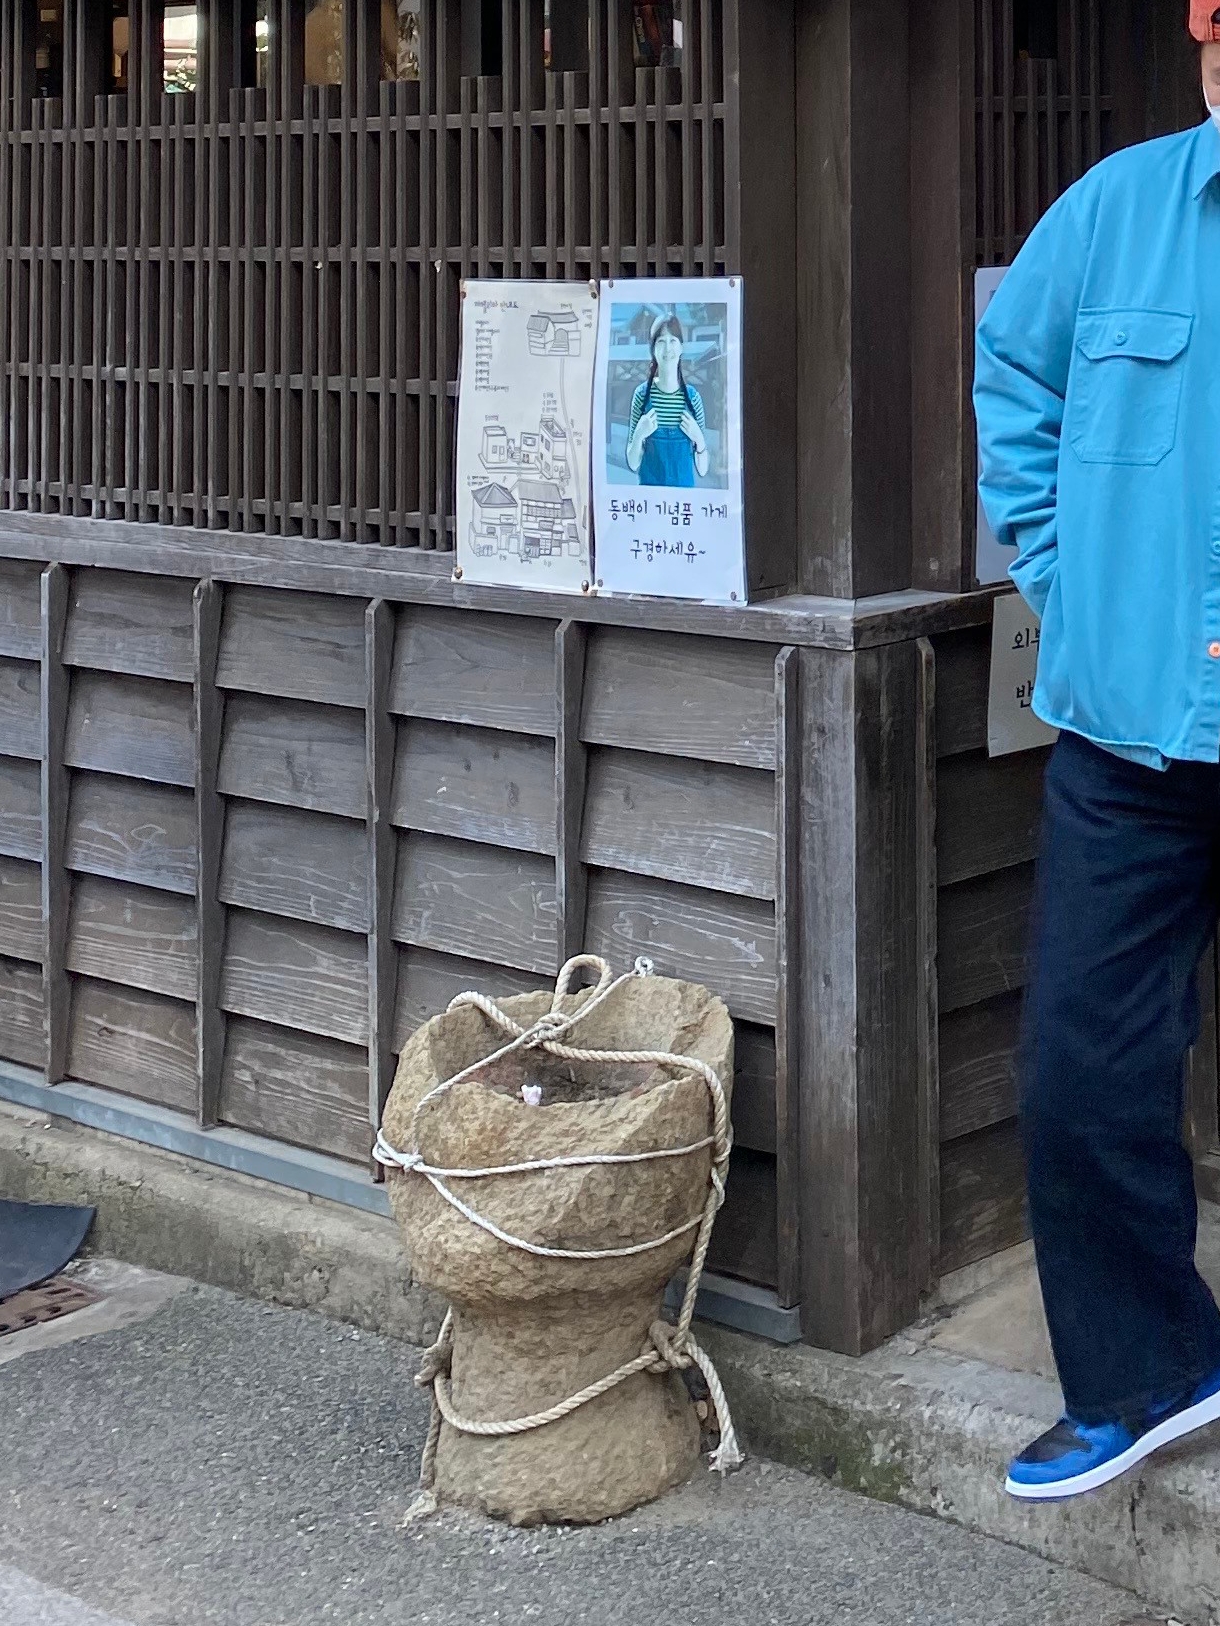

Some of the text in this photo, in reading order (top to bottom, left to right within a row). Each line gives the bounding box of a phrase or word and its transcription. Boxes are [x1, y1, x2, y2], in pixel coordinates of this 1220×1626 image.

[608, 499, 728, 526] 동백이 기념품 가게
